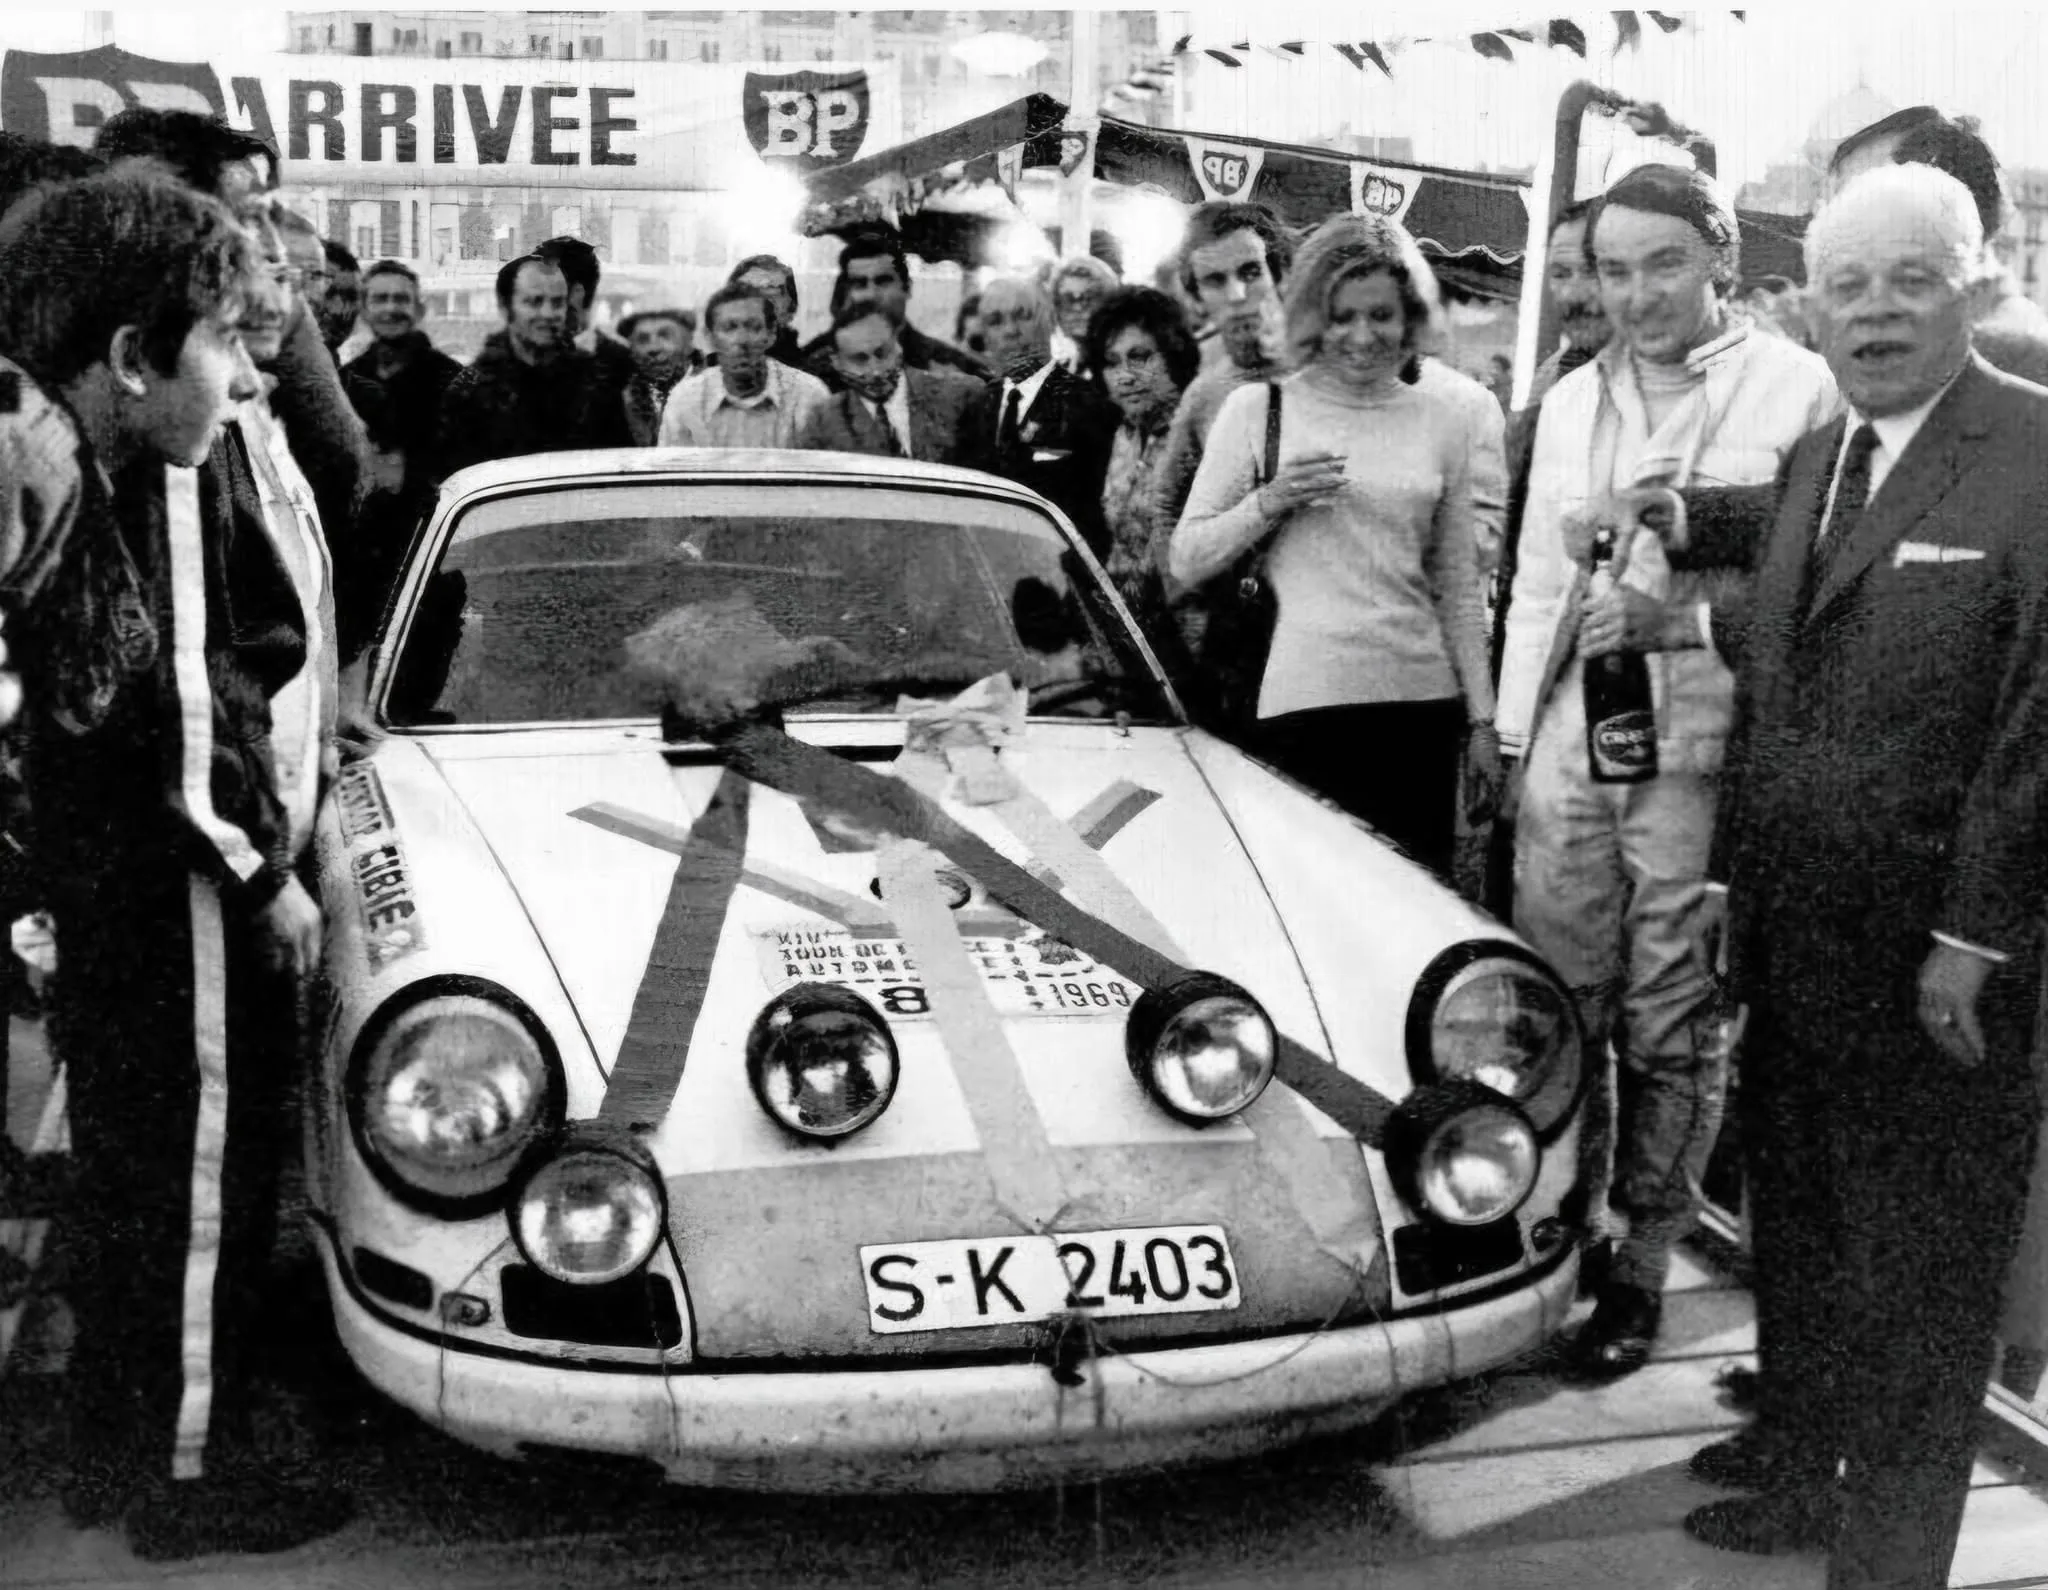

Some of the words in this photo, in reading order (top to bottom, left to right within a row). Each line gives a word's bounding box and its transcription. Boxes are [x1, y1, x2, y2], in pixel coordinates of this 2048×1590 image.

[231, 77, 637, 166] ARRIVEE
[760, 90, 859, 157] BP
[359, 845, 416, 934] CIBIE
[1049, 981, 1130, 1008] 1969
[870, 1246, 1026, 1322] S-K
[1056, 1235, 1233, 1308] 2403
